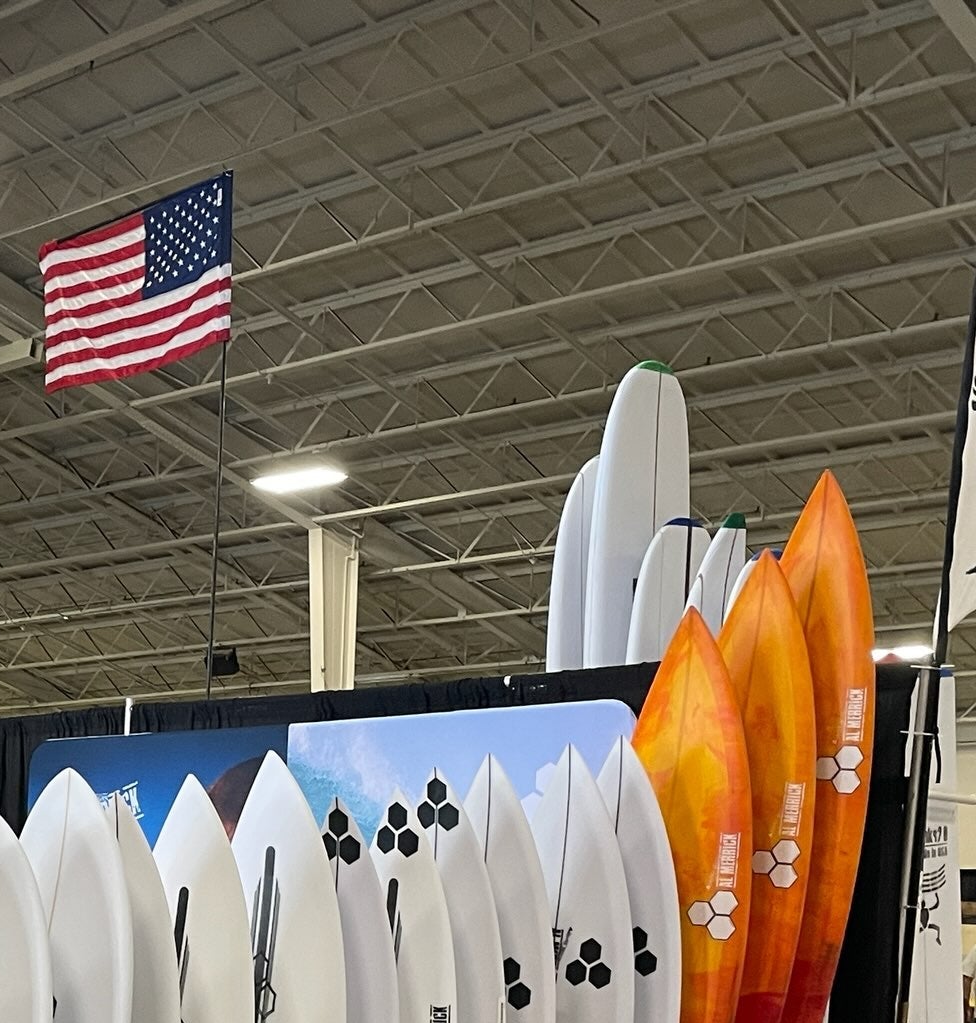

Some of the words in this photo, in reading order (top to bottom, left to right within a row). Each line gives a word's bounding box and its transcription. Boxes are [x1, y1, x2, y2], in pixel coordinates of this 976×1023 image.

[847, 688, 864, 729] MERRICK
[845, 730, 860, 742] AL
[783, 783, 803, 824] MERRICK
[781, 826, 796, 837] AL
[720, 833, 737, 875] MERRICK
[718, 877, 734, 888] AL
